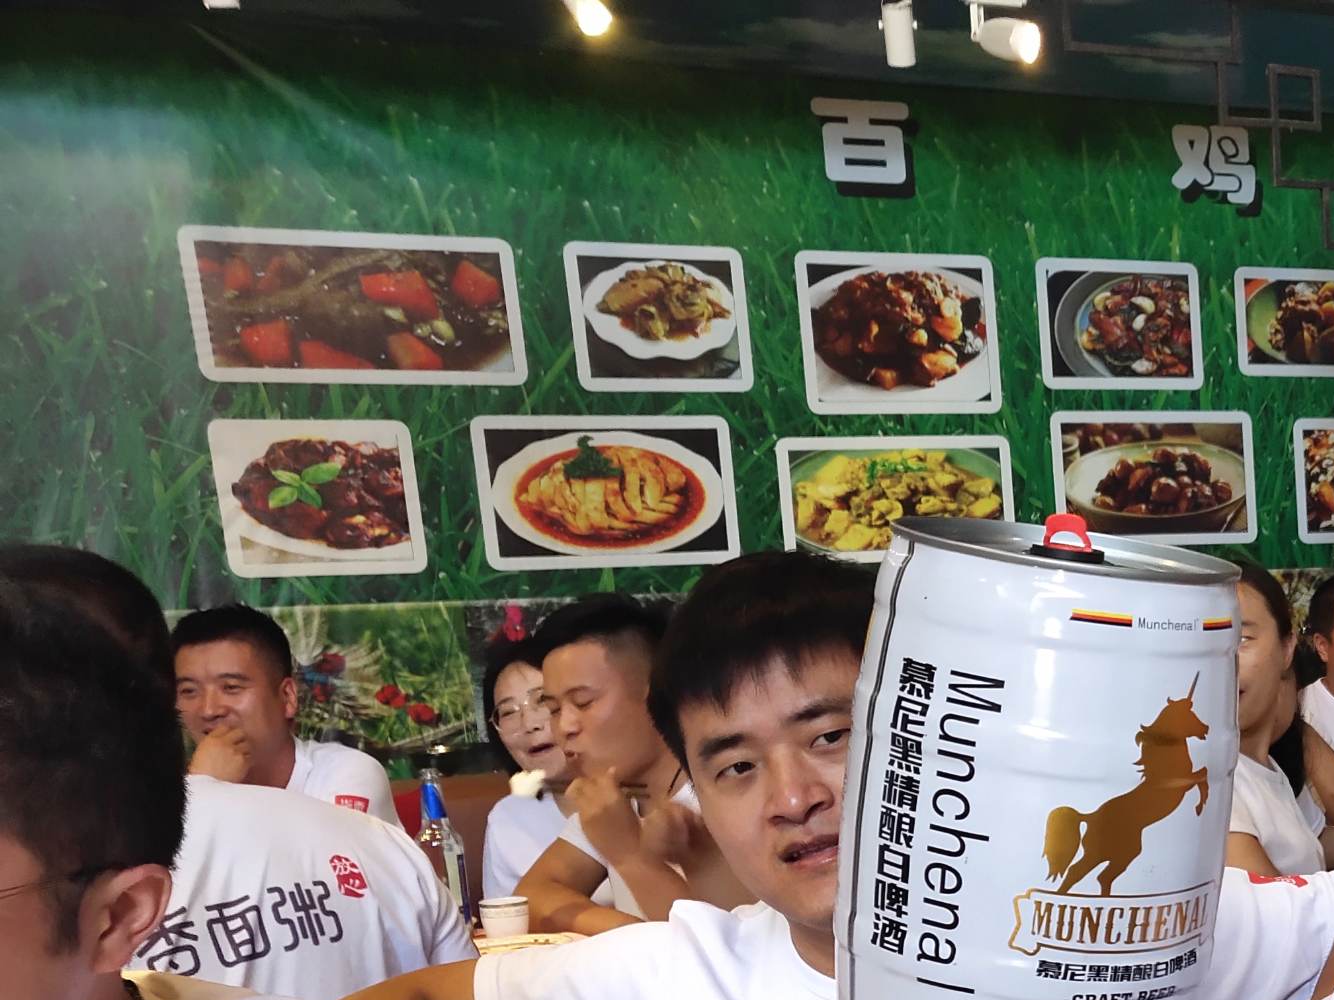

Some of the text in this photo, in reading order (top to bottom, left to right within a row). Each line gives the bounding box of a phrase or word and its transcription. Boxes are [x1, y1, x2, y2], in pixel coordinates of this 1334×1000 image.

[810, 96, 910, 186] 百
[1170, 124, 1258, 205] 鸡
[1137, 616, 1197, 632] Munchenal
[870, 656, 938, 956] 慕尼黑精酿白啤酒
[915, 668, 1006, 995] Munchenal
[1031, 892, 1209, 945] MUNCHENAL
[1035, 948, 1198, 983] 慕尼黑精酿白啤酒
